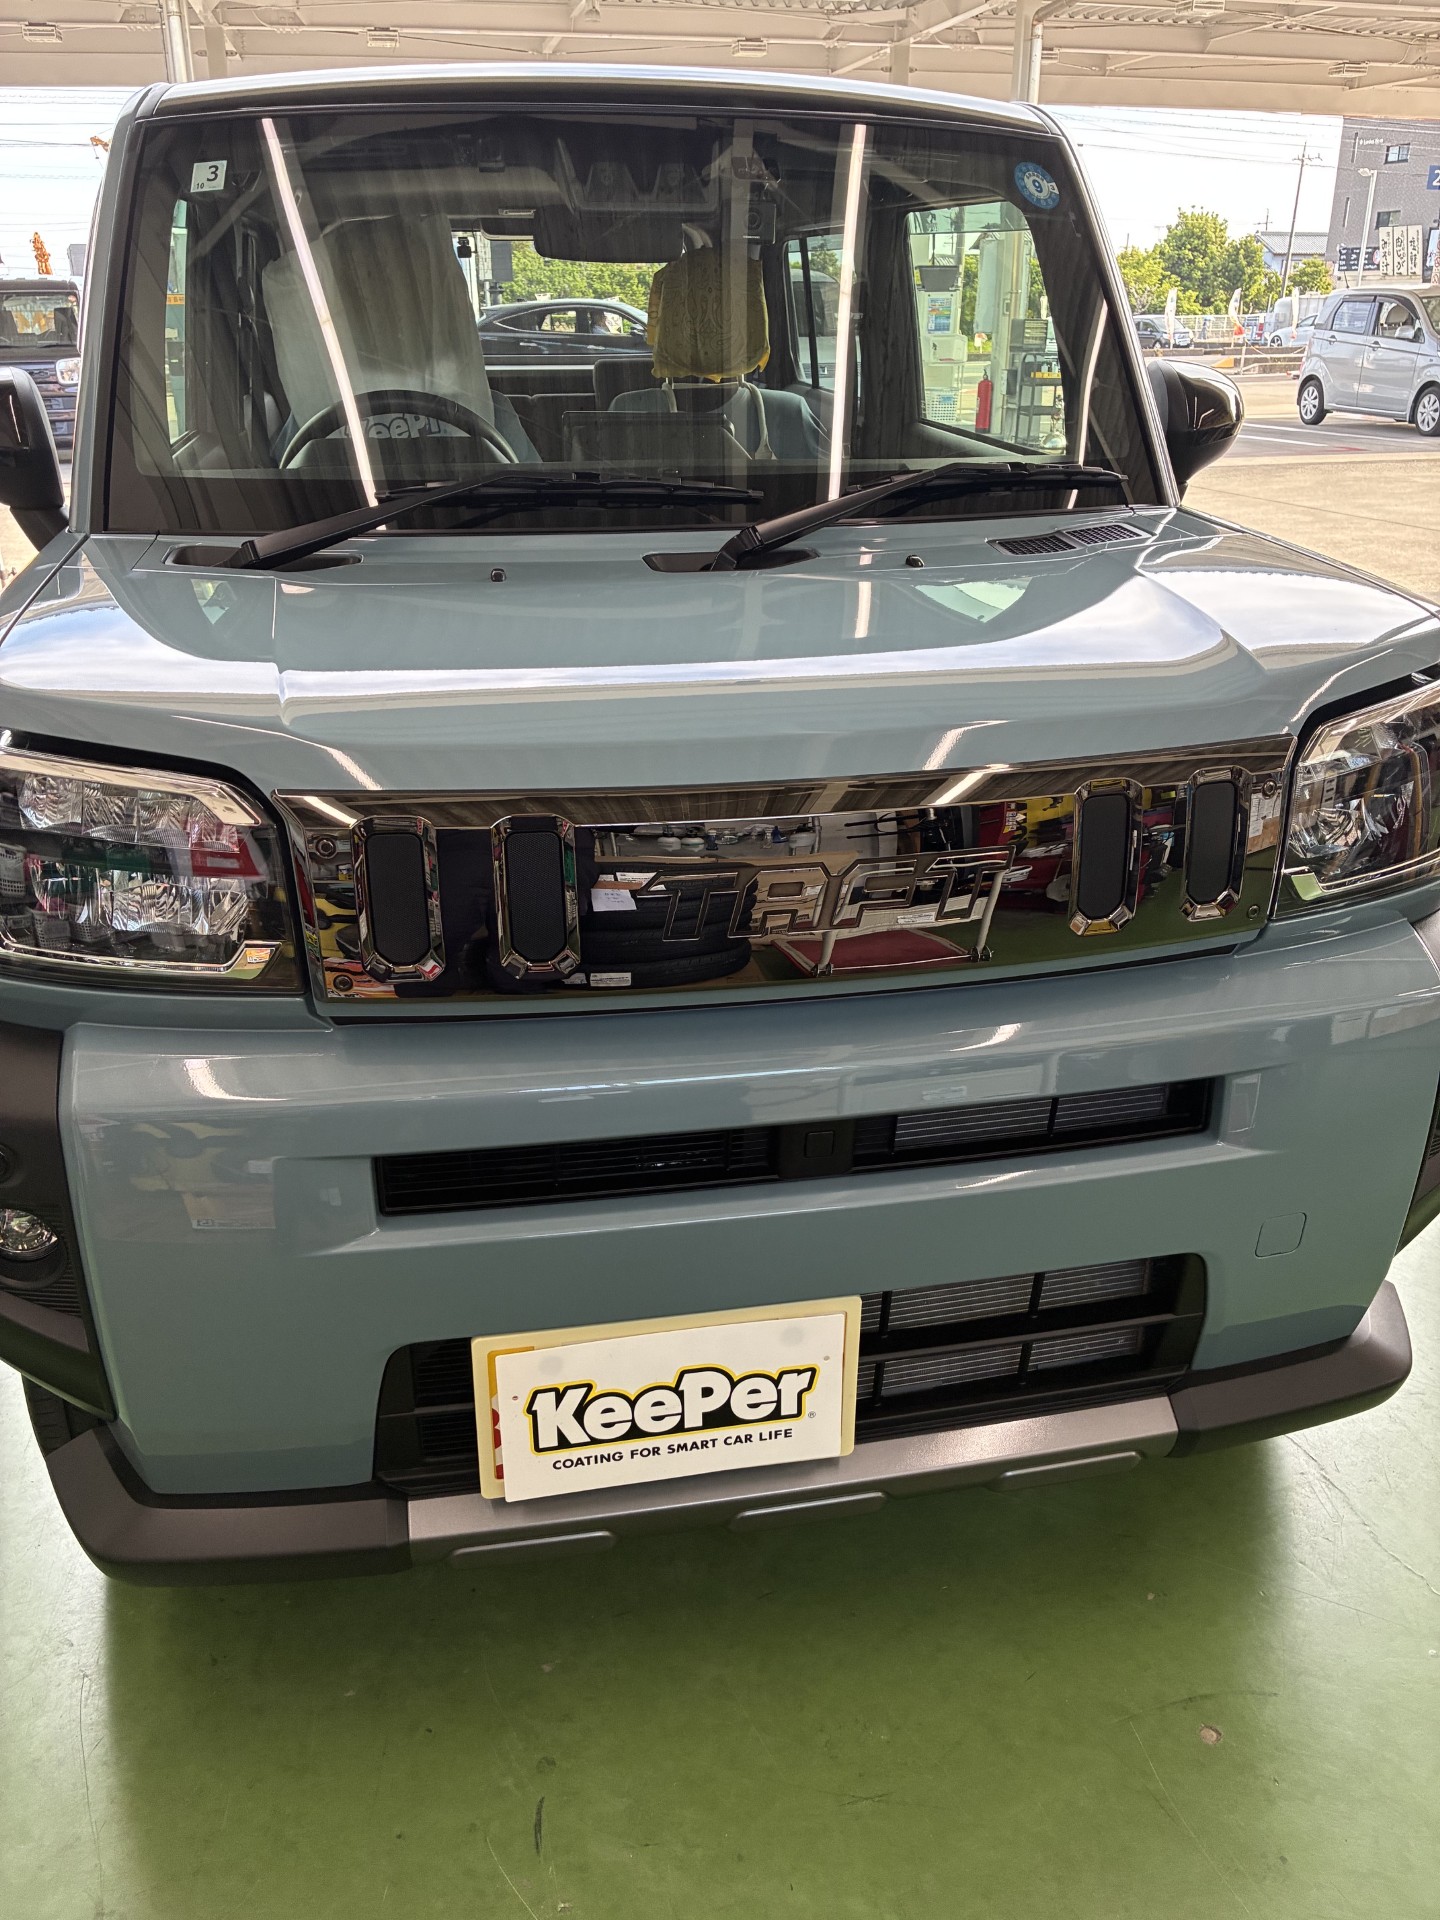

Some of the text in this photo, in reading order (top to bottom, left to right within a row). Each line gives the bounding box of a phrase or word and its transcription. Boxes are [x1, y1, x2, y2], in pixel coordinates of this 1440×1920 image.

[206, 164, 219, 182] 3
[636, 844, 1017, 941] TAFT
[527, 1366, 817, 1452] KeePer
[552, 1428, 793, 1470] COATING FOR SMART CAR LIFE
